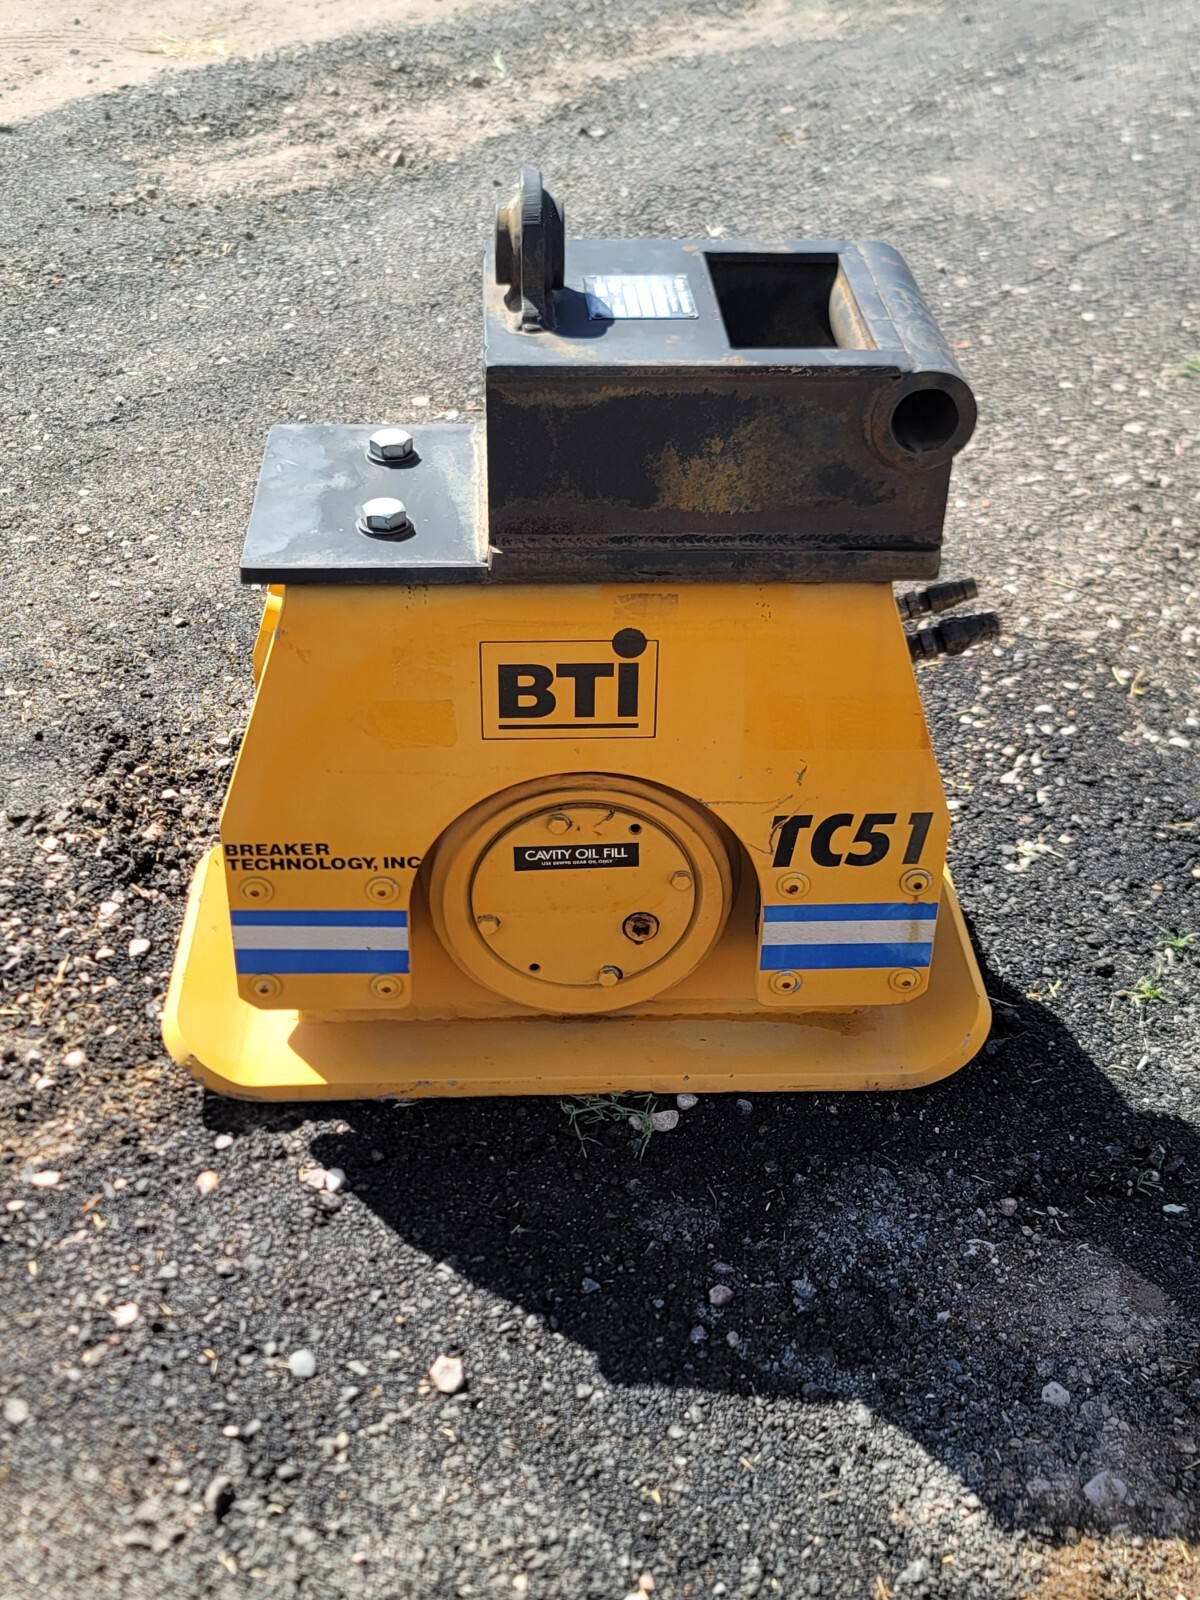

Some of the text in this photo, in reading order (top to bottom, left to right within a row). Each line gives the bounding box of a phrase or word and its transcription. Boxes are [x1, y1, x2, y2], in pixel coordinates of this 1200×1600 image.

[771, 812, 934, 868] TC51
[225, 843, 330, 857] BREAKER
[524, 847, 629, 861] CAVITY OIL FILL
[227, 857, 378, 872] TECHNOLOGY,
